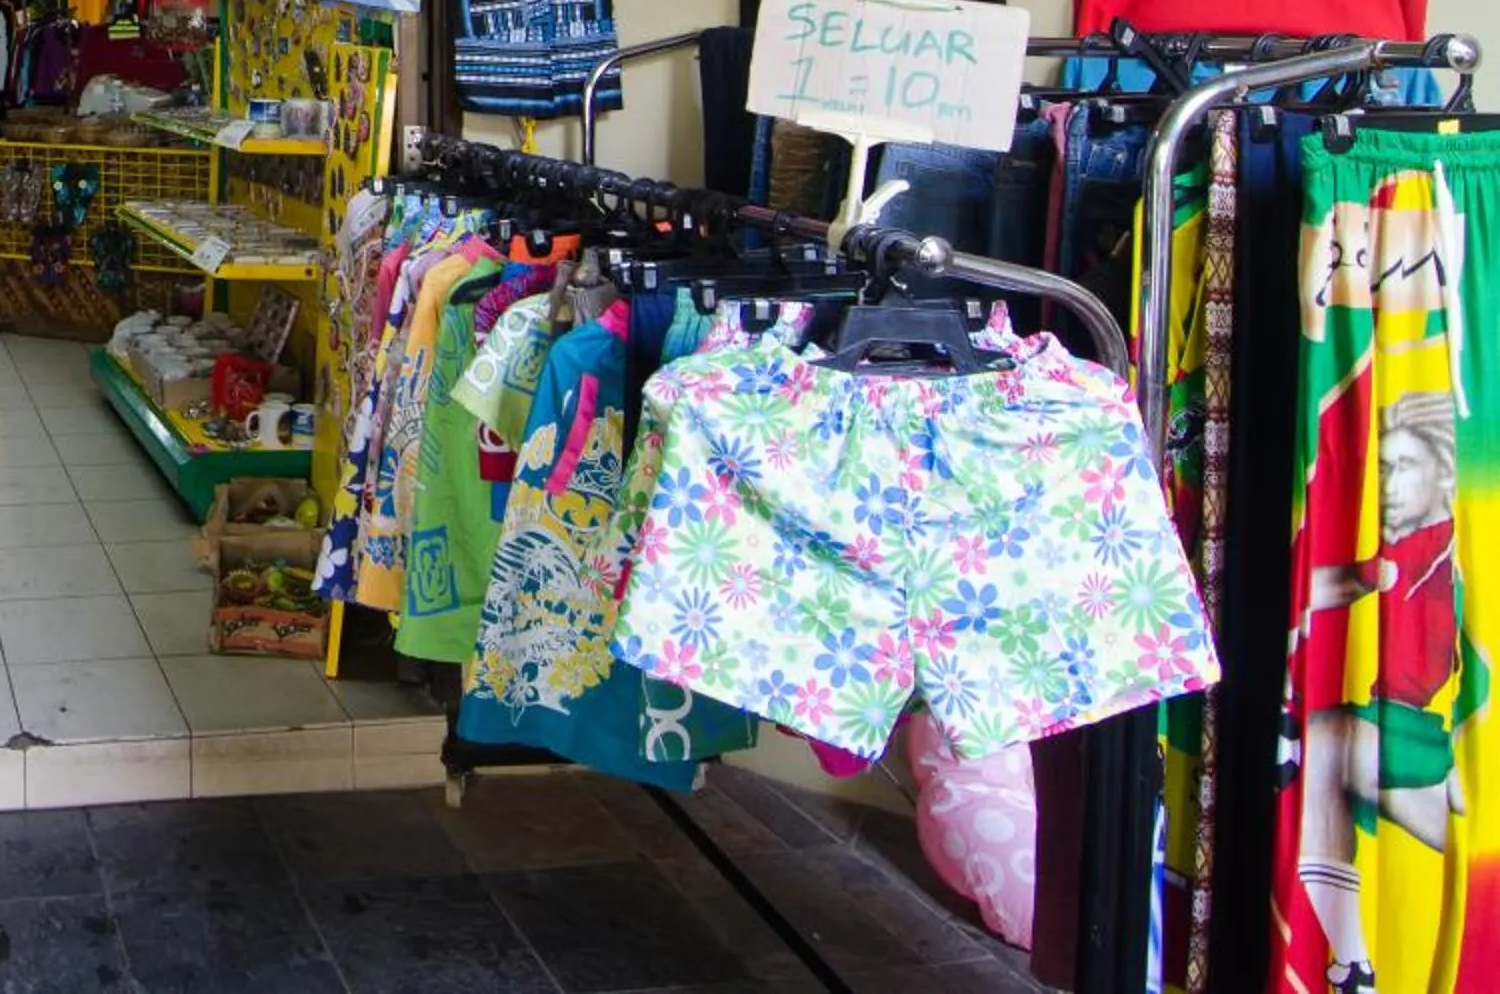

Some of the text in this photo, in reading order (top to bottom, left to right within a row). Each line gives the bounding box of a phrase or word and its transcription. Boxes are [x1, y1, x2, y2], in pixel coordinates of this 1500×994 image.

[785, 2, 979, 66] SELUAR
[776, 55, 825, 106] 1
[883, 65, 940, 108] 10
